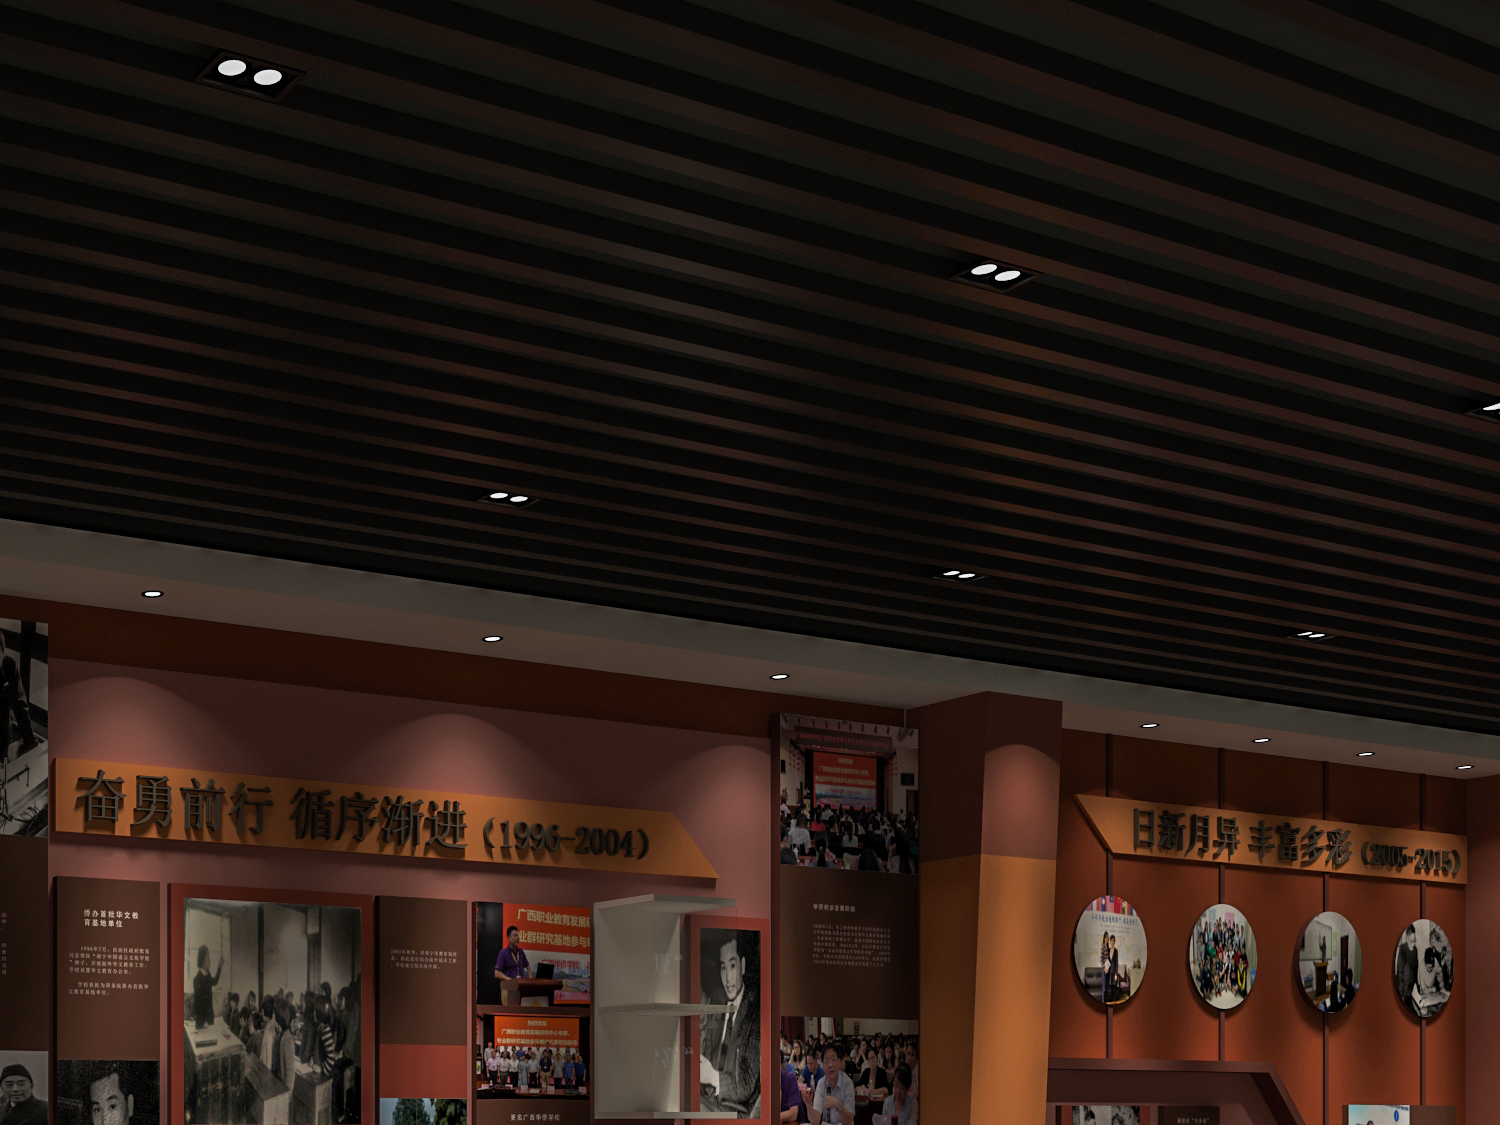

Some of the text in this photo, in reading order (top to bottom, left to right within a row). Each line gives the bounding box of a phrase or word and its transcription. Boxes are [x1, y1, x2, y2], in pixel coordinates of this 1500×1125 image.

[77, 769, 274, 836] 奋勇前行
[289, 786, 468, 850] 循序渐进
[1133, 808, 1241, 861] 日新月异
[1248, 820, 1353, 867] 丰富多彩
[84, 918, 123, 928] 育基地单位
